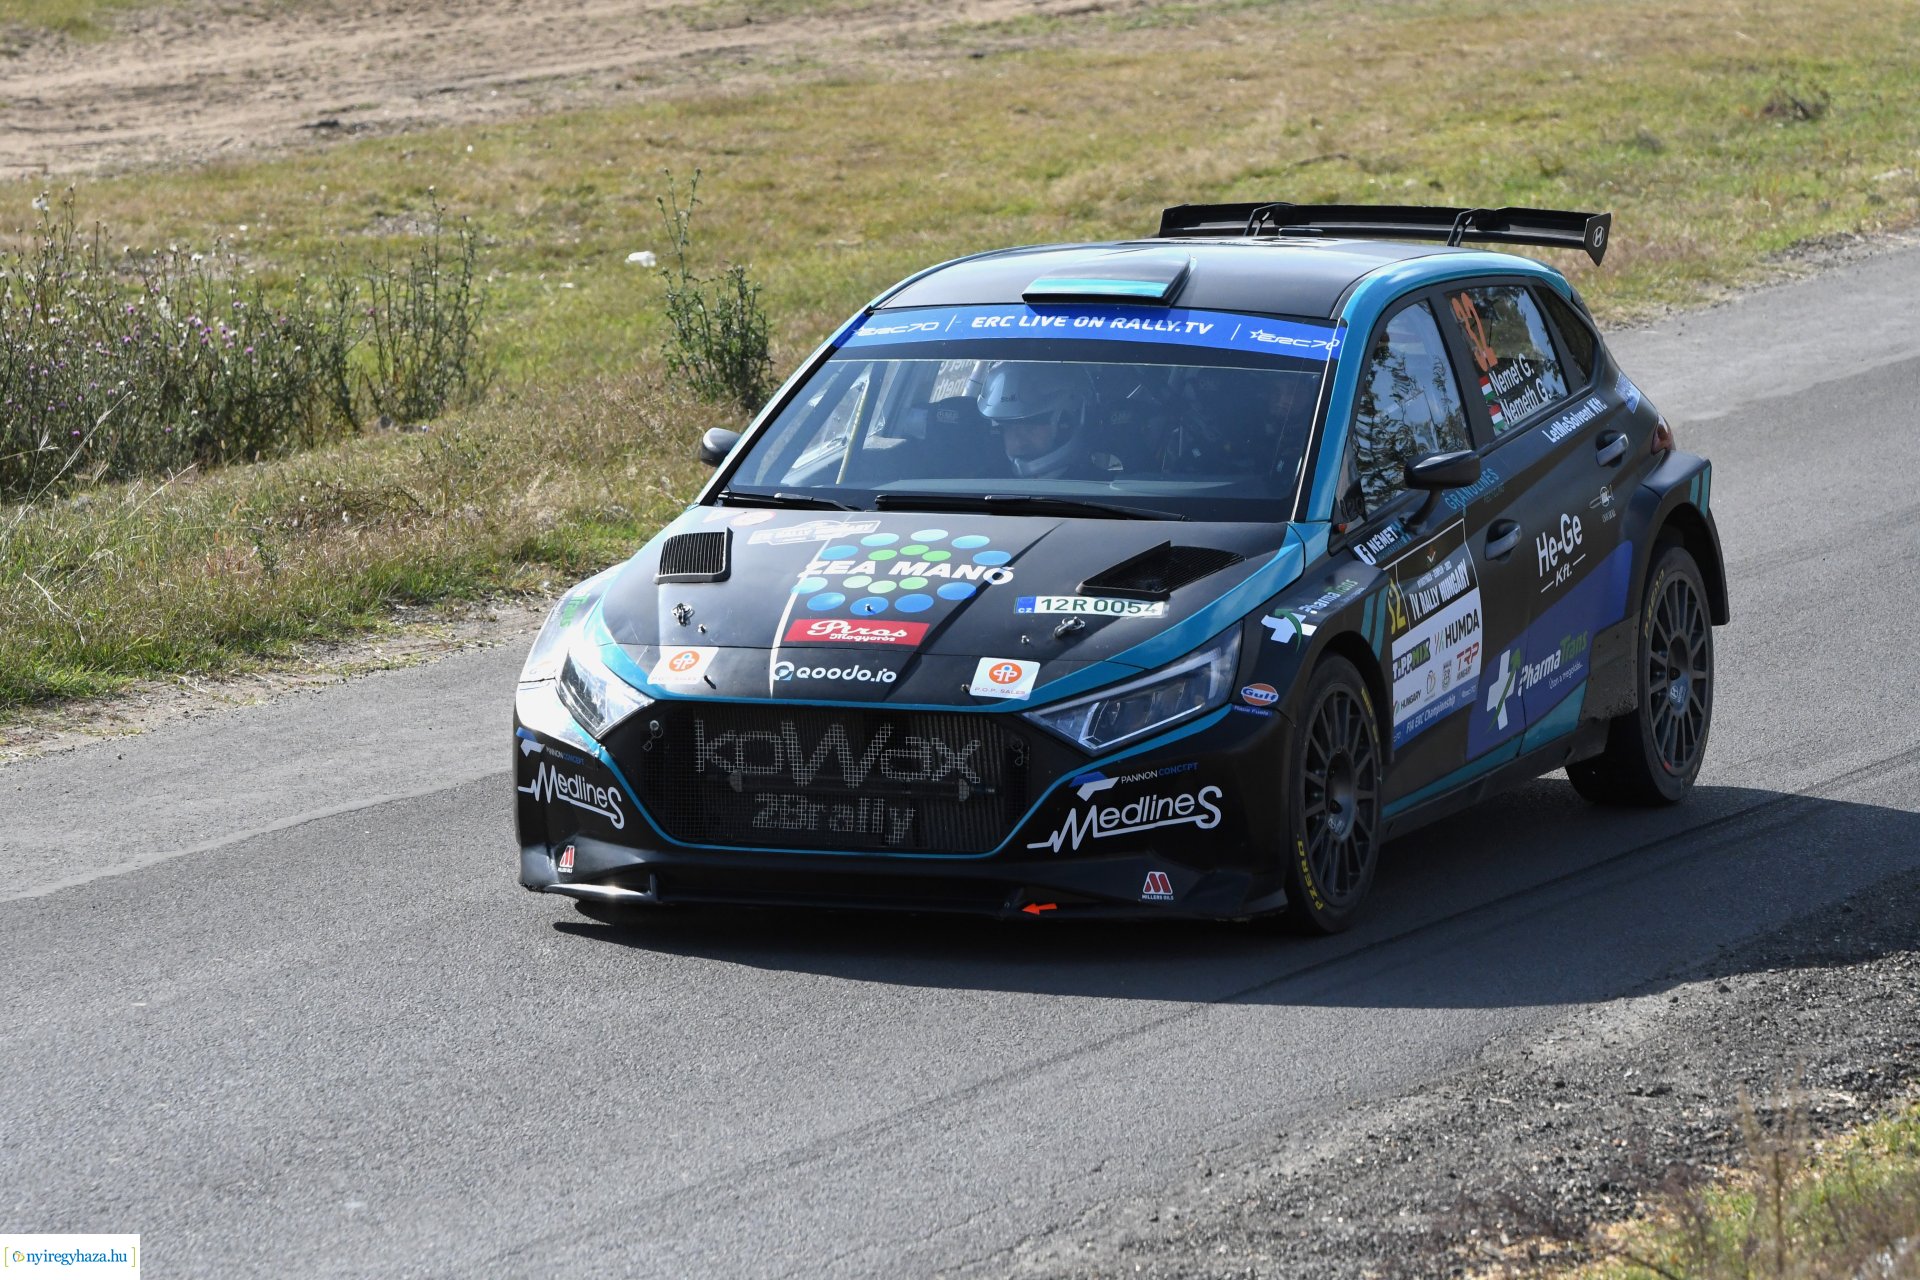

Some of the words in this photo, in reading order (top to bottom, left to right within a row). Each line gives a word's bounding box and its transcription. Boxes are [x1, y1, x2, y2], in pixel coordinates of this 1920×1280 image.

[971, 315, 1016, 328] ERC
[1018, 315, 1070, 328] LIVE
[1073, 315, 1104, 328] ON
[1110, 317, 1215, 335] RALLY.TV
[1488, 358, 1524, 397] Nemet
[1518, 352, 1535, 378] G.
[1500, 384, 1541, 425] Nemeth
[1535, 377, 1552, 402] G.
[1541, 405, 1596, 443] LetMeSolvent
[1535, 513, 1583, 578] He-Ge
[797, 560, 877, 578] ZEA
[1419, 584, 1441, 616] RALLY
[1438, 557, 1471, 604] HUNGARY
[1041, 598, 1087, 612] 12R
[1093, 599, 1158, 615] 0054
[1444, 607, 1481, 650] HUMDA
[1517, 629, 1588, 697] PharmaTrans
[1242, 688, 1278, 702] Gulf
[1120, 770, 1158, 785] PANNON
[1158, 762, 1198, 777] CONCEPT
